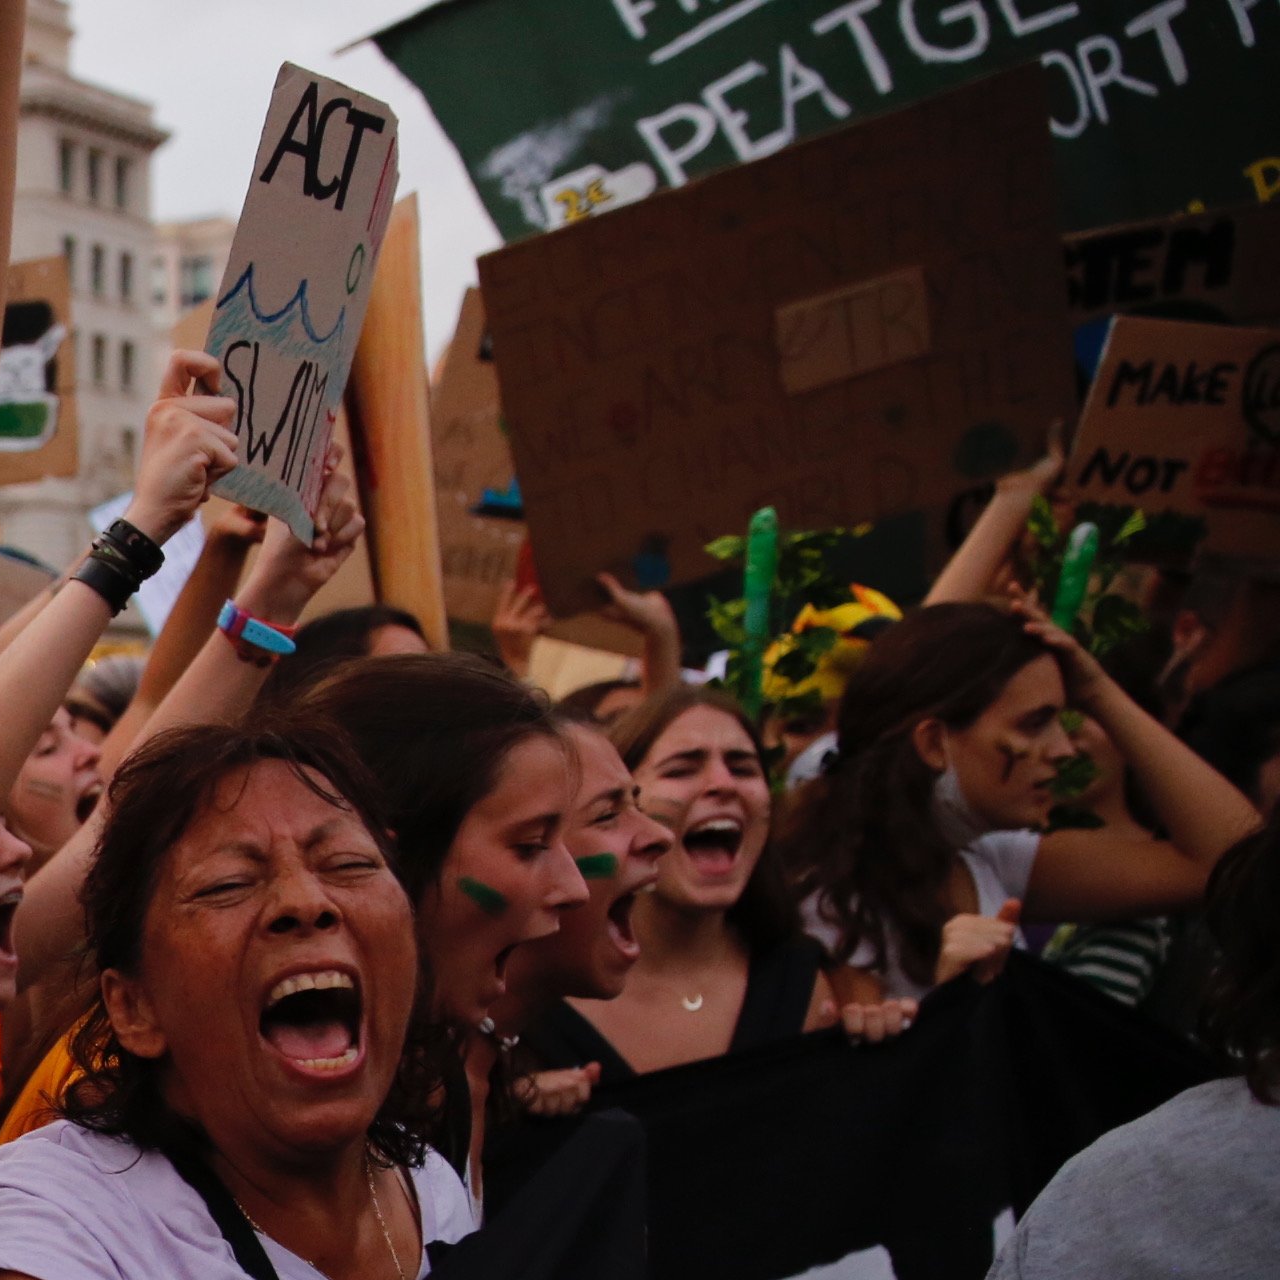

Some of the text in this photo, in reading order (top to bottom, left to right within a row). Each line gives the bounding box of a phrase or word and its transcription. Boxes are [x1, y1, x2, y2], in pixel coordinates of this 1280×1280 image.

[260, 81, 385, 211] ACT
[1064, 216, 1236, 311] TEM
[222, 339, 331, 493] SWIM
[1107, 360, 1238, 409] MAKE
[1077, 447, 1190, 495] NOT
